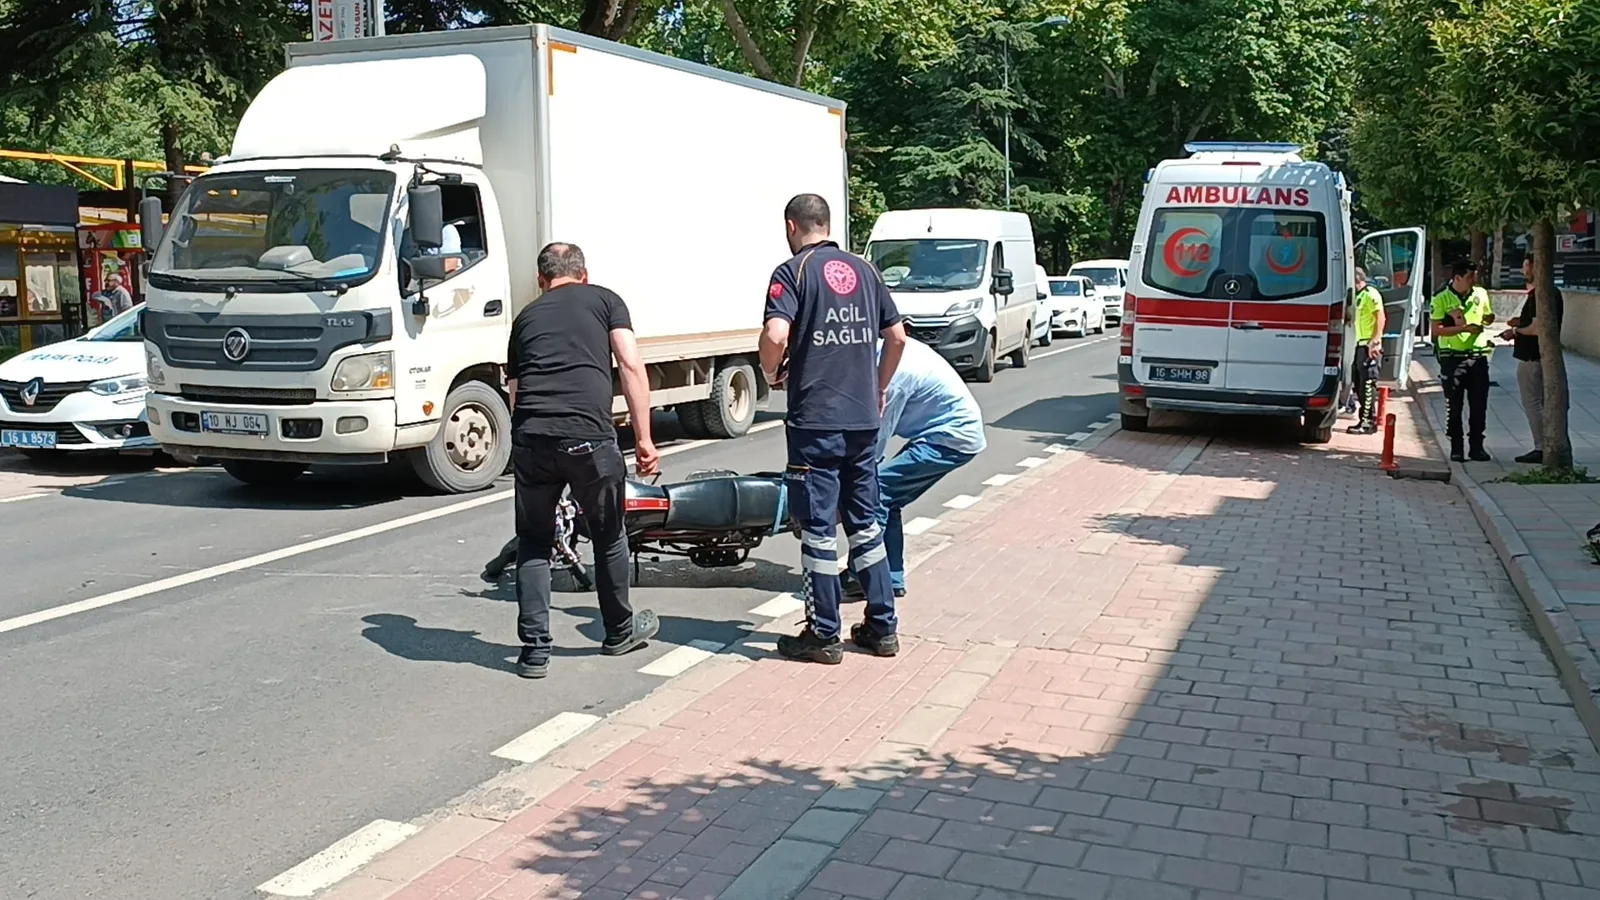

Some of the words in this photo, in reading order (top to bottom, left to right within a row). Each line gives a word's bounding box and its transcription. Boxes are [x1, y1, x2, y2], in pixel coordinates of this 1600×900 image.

[1165, 186, 1309, 207] AMBULANS
[1175, 242, 1212, 262] 112
[825, 303, 866, 323] ACİL
[1155, 368, 1166, 377] 16
[1195, 370, 1208, 380] 98
[209, 414, 219, 427] 10
[243, 416, 260, 429] 064
[8, 432, 19, 443] 16
[31, 432, 55, 444] 8573
